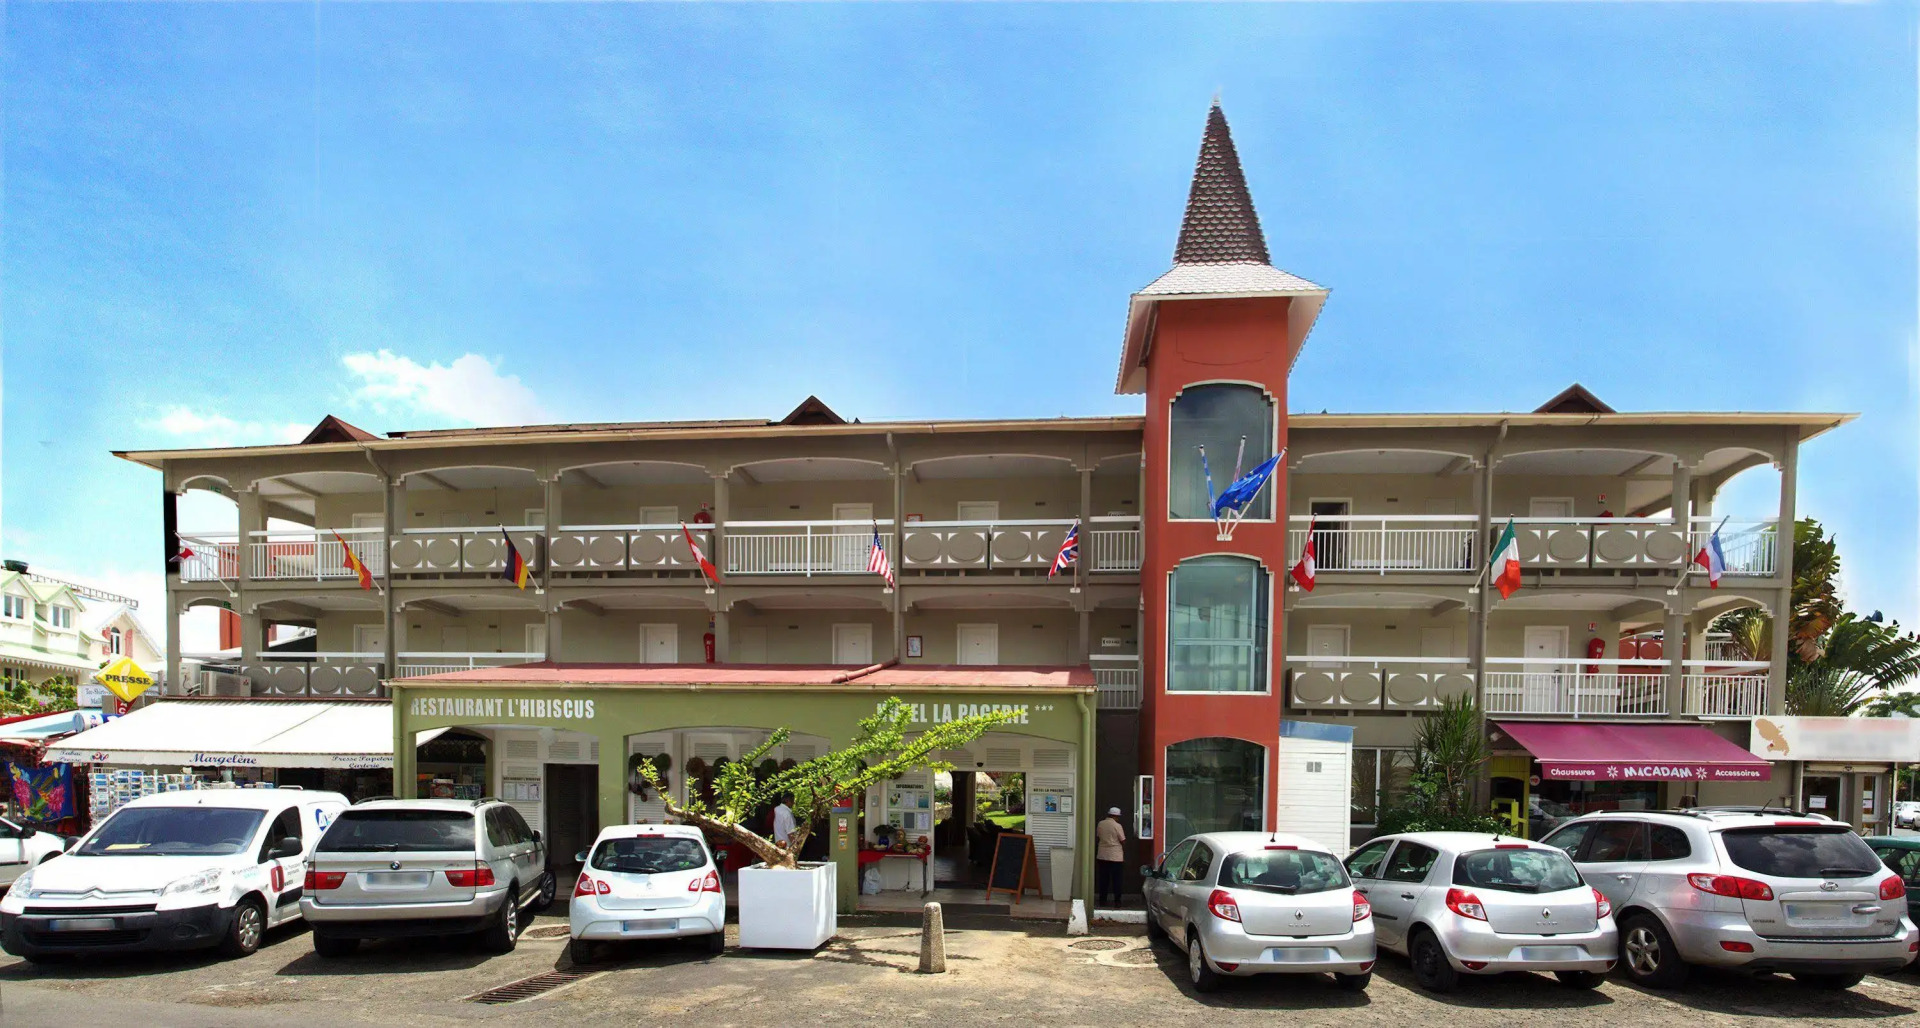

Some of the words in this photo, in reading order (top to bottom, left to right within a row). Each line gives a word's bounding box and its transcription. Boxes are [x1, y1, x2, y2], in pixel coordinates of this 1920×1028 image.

[105, 674, 151, 685] PRESSE
[410, 697, 503, 717] RESTAURANT
[507, 698, 595, 719] L'HIBISCUS
[876, 703, 928, 723] HEL
[933, 703, 952, 723] LA
[189, 753, 257, 765] Margelène
[1550, 768, 1596, 776] Chaussures
[1624, 766, 1693, 778] MACADAM
[1714, 769, 1760, 777] Accessoires
